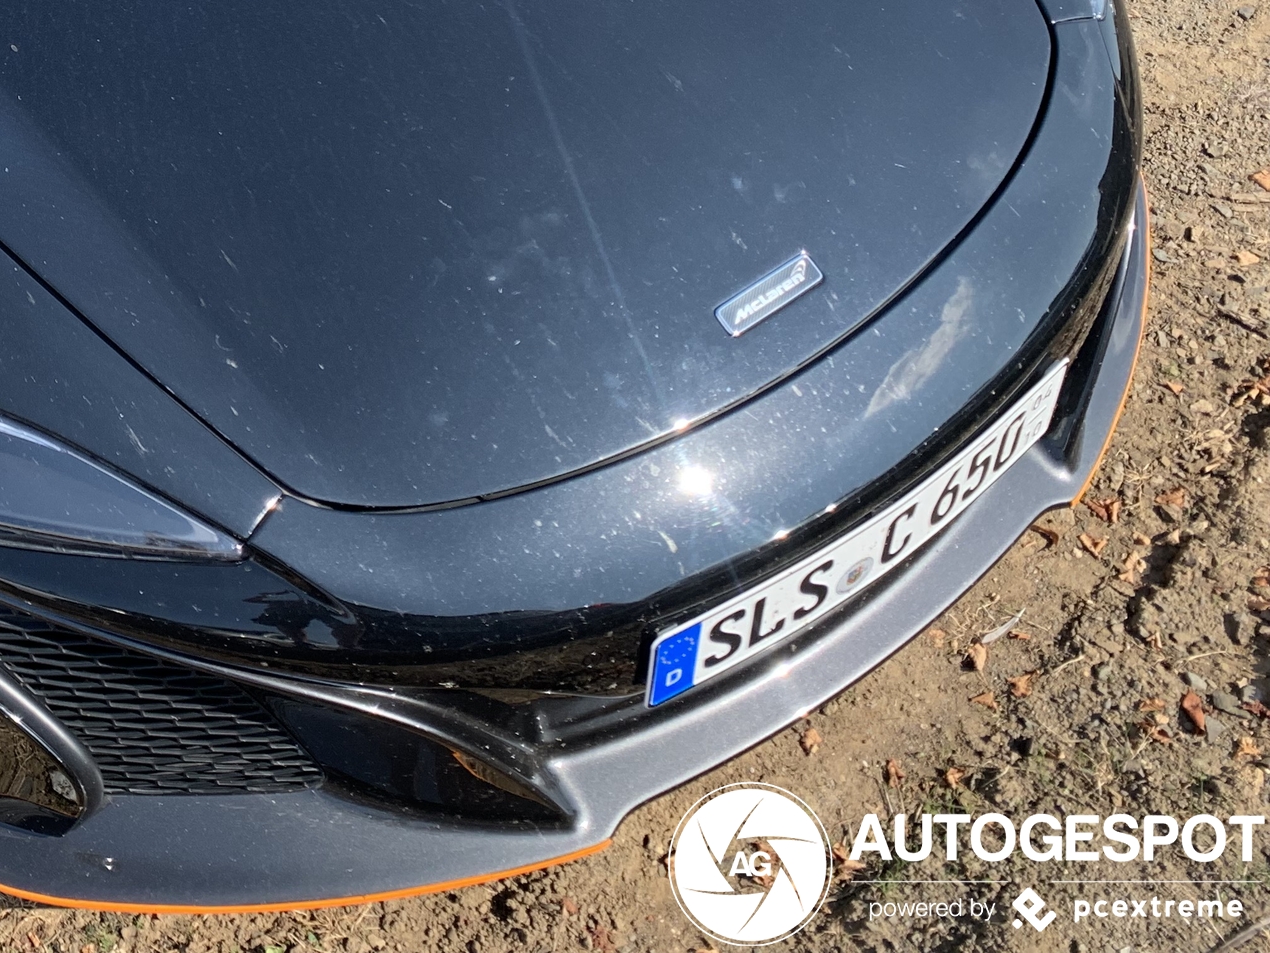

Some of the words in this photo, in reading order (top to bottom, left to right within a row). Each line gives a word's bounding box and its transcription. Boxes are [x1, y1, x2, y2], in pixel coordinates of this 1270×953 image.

[734, 272, 806, 325] McLaren
[704, 559, 834, 668] SLS
[881, 502, 918, 564] C
[930, 411, 1027, 526] 650
[665, 668, 683, 687] D
